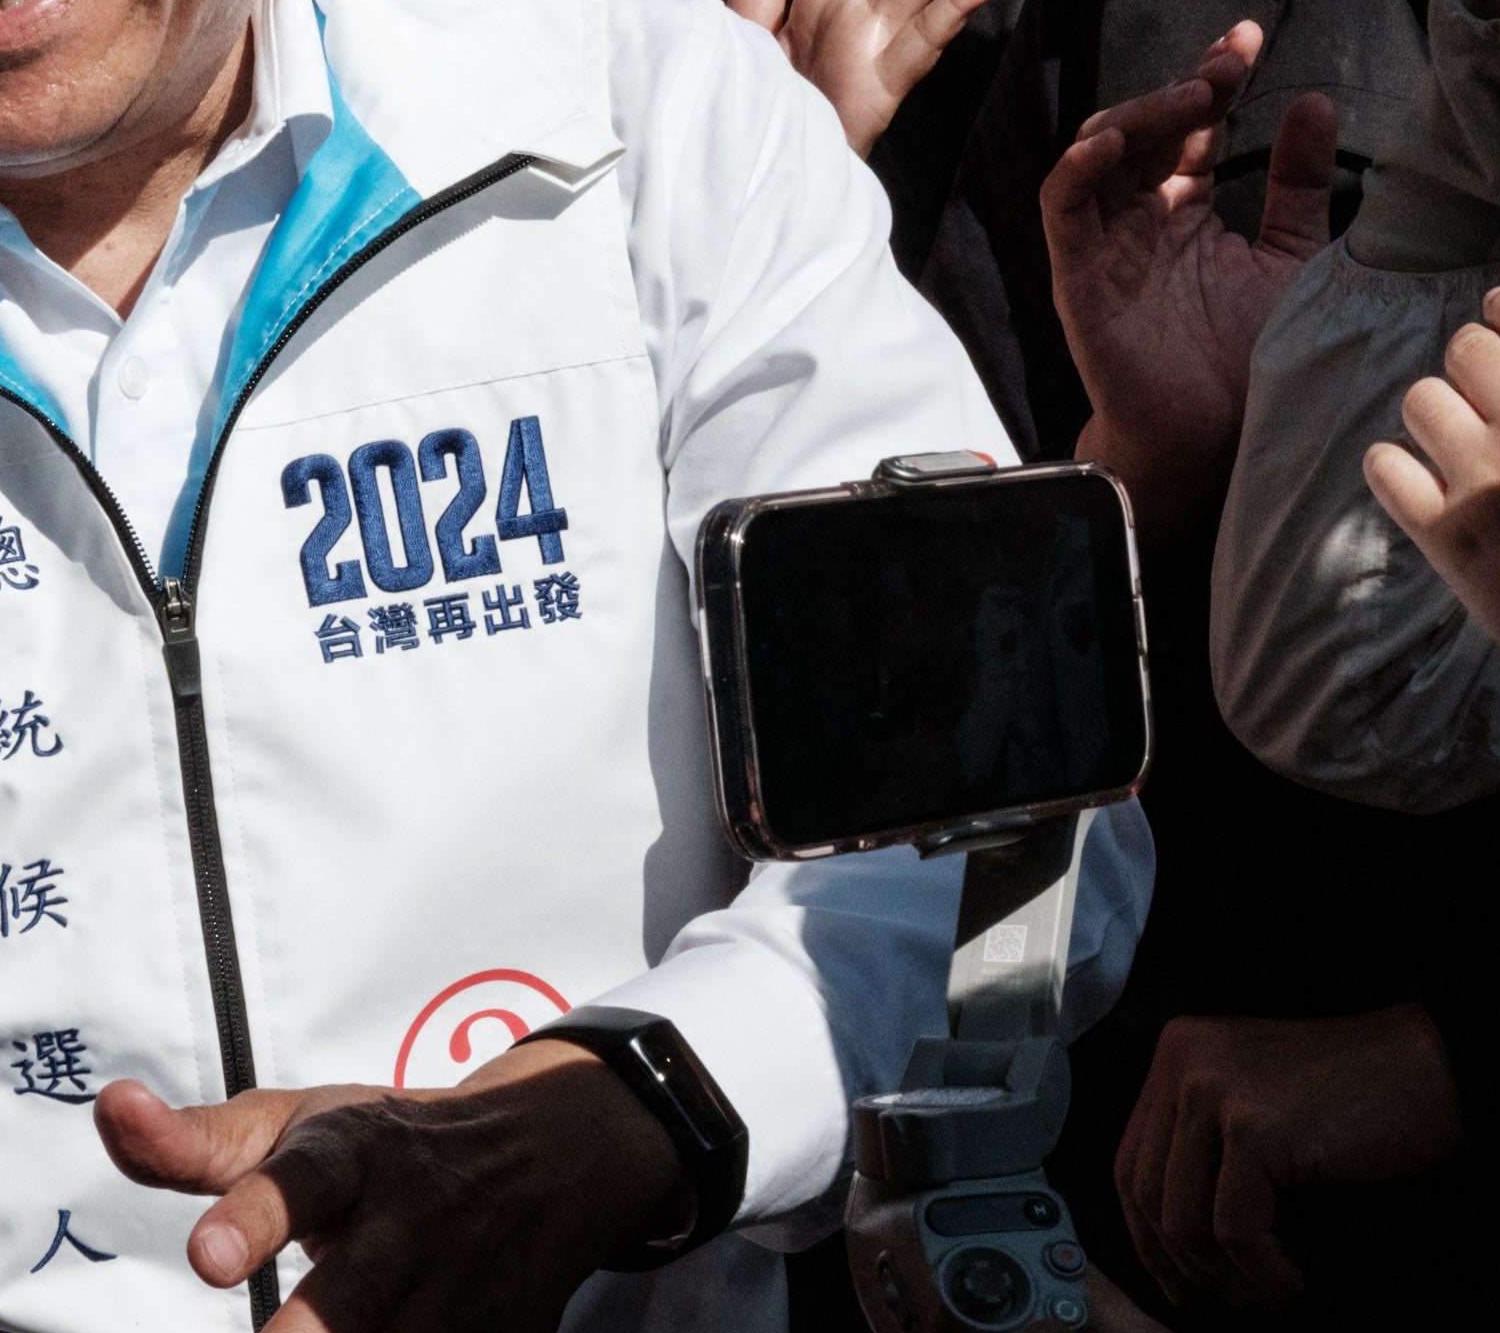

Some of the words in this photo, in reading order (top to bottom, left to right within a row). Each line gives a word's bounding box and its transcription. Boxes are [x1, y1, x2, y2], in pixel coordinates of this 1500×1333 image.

[280, 414, 569, 608] 2024
[316, 572, 582, 664] 台灣再出發
